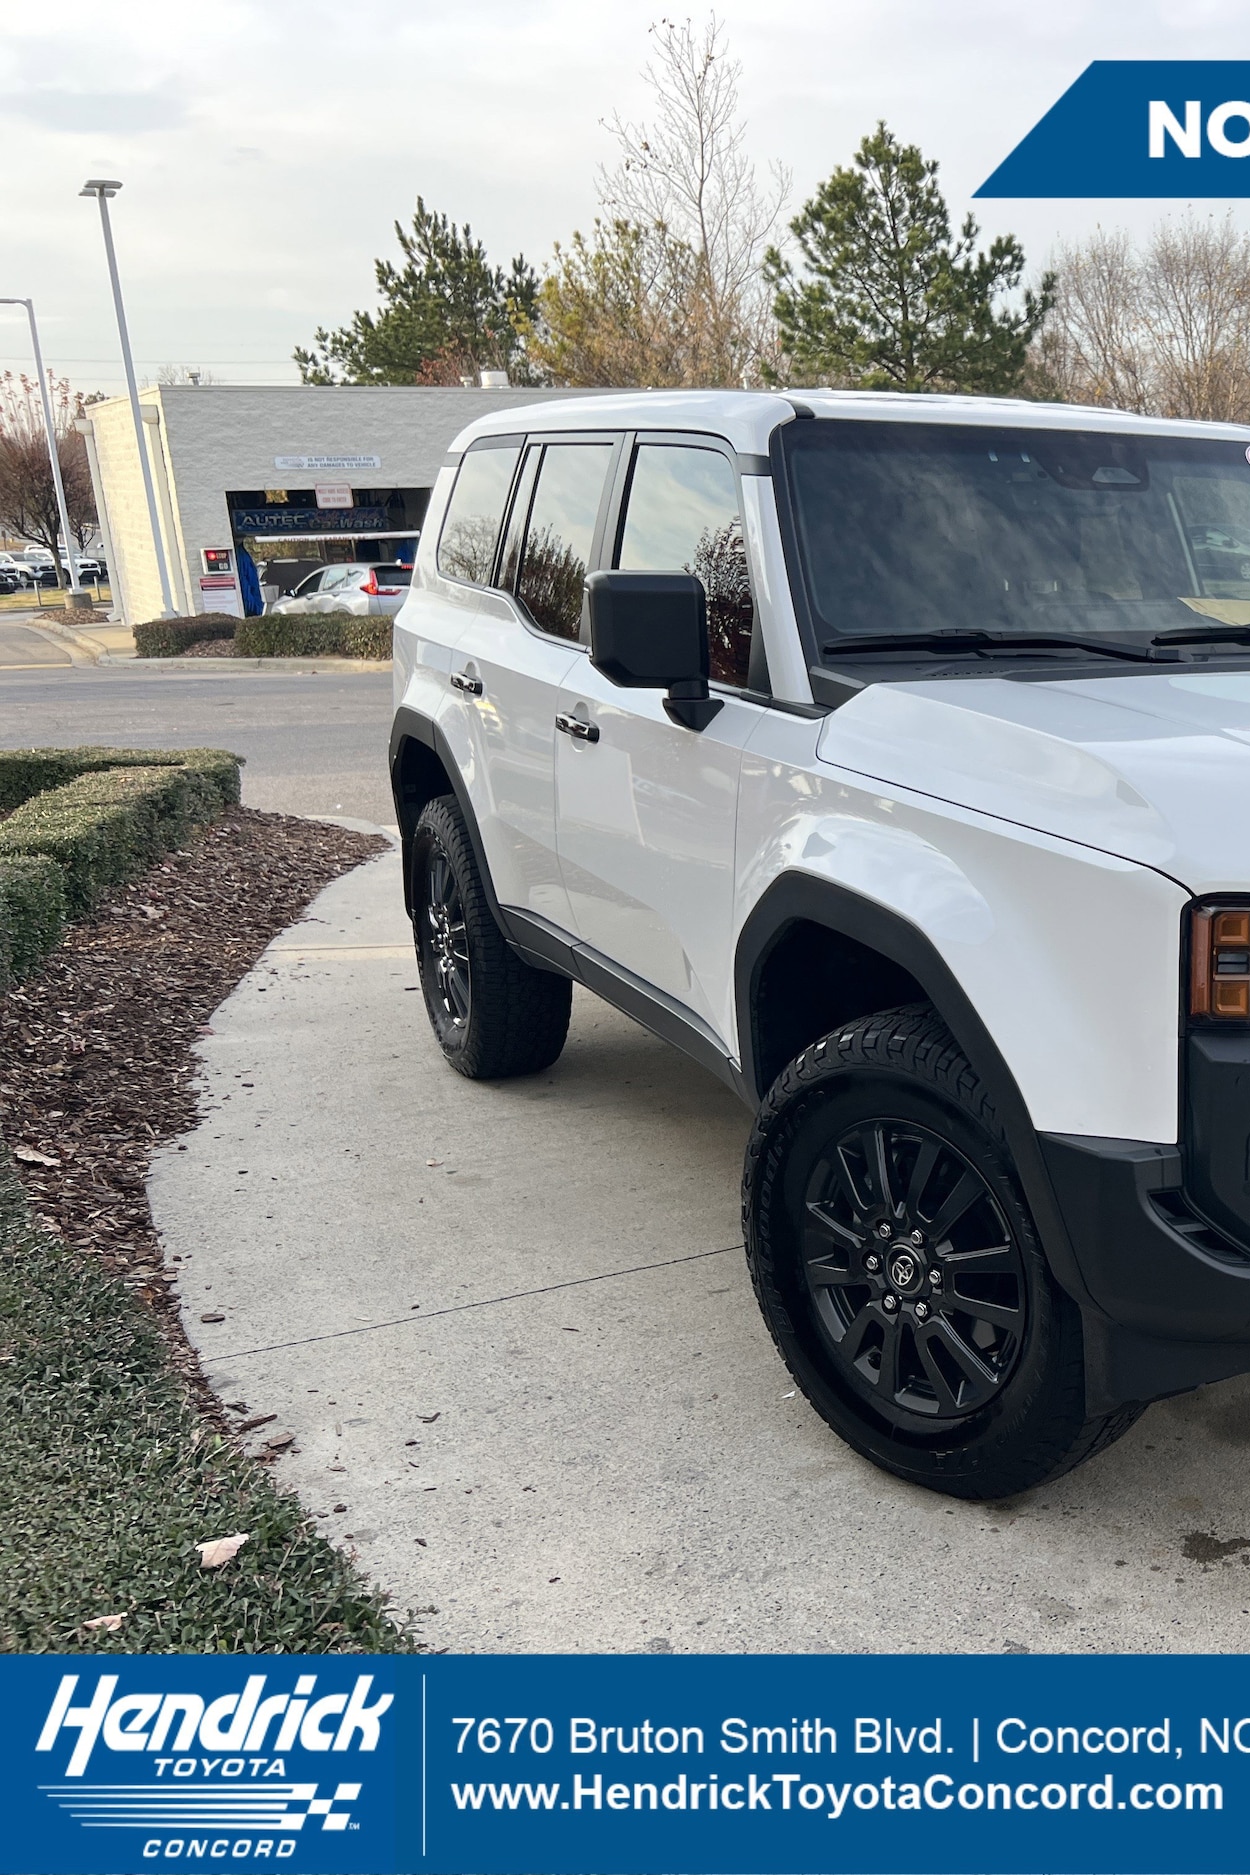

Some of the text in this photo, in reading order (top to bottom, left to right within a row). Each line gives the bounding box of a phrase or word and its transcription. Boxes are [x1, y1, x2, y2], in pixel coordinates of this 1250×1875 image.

[241, 514, 307, 527] AUTEC
[340, 517, 383, 529] Wash
[218, 562, 229, 570] GO
